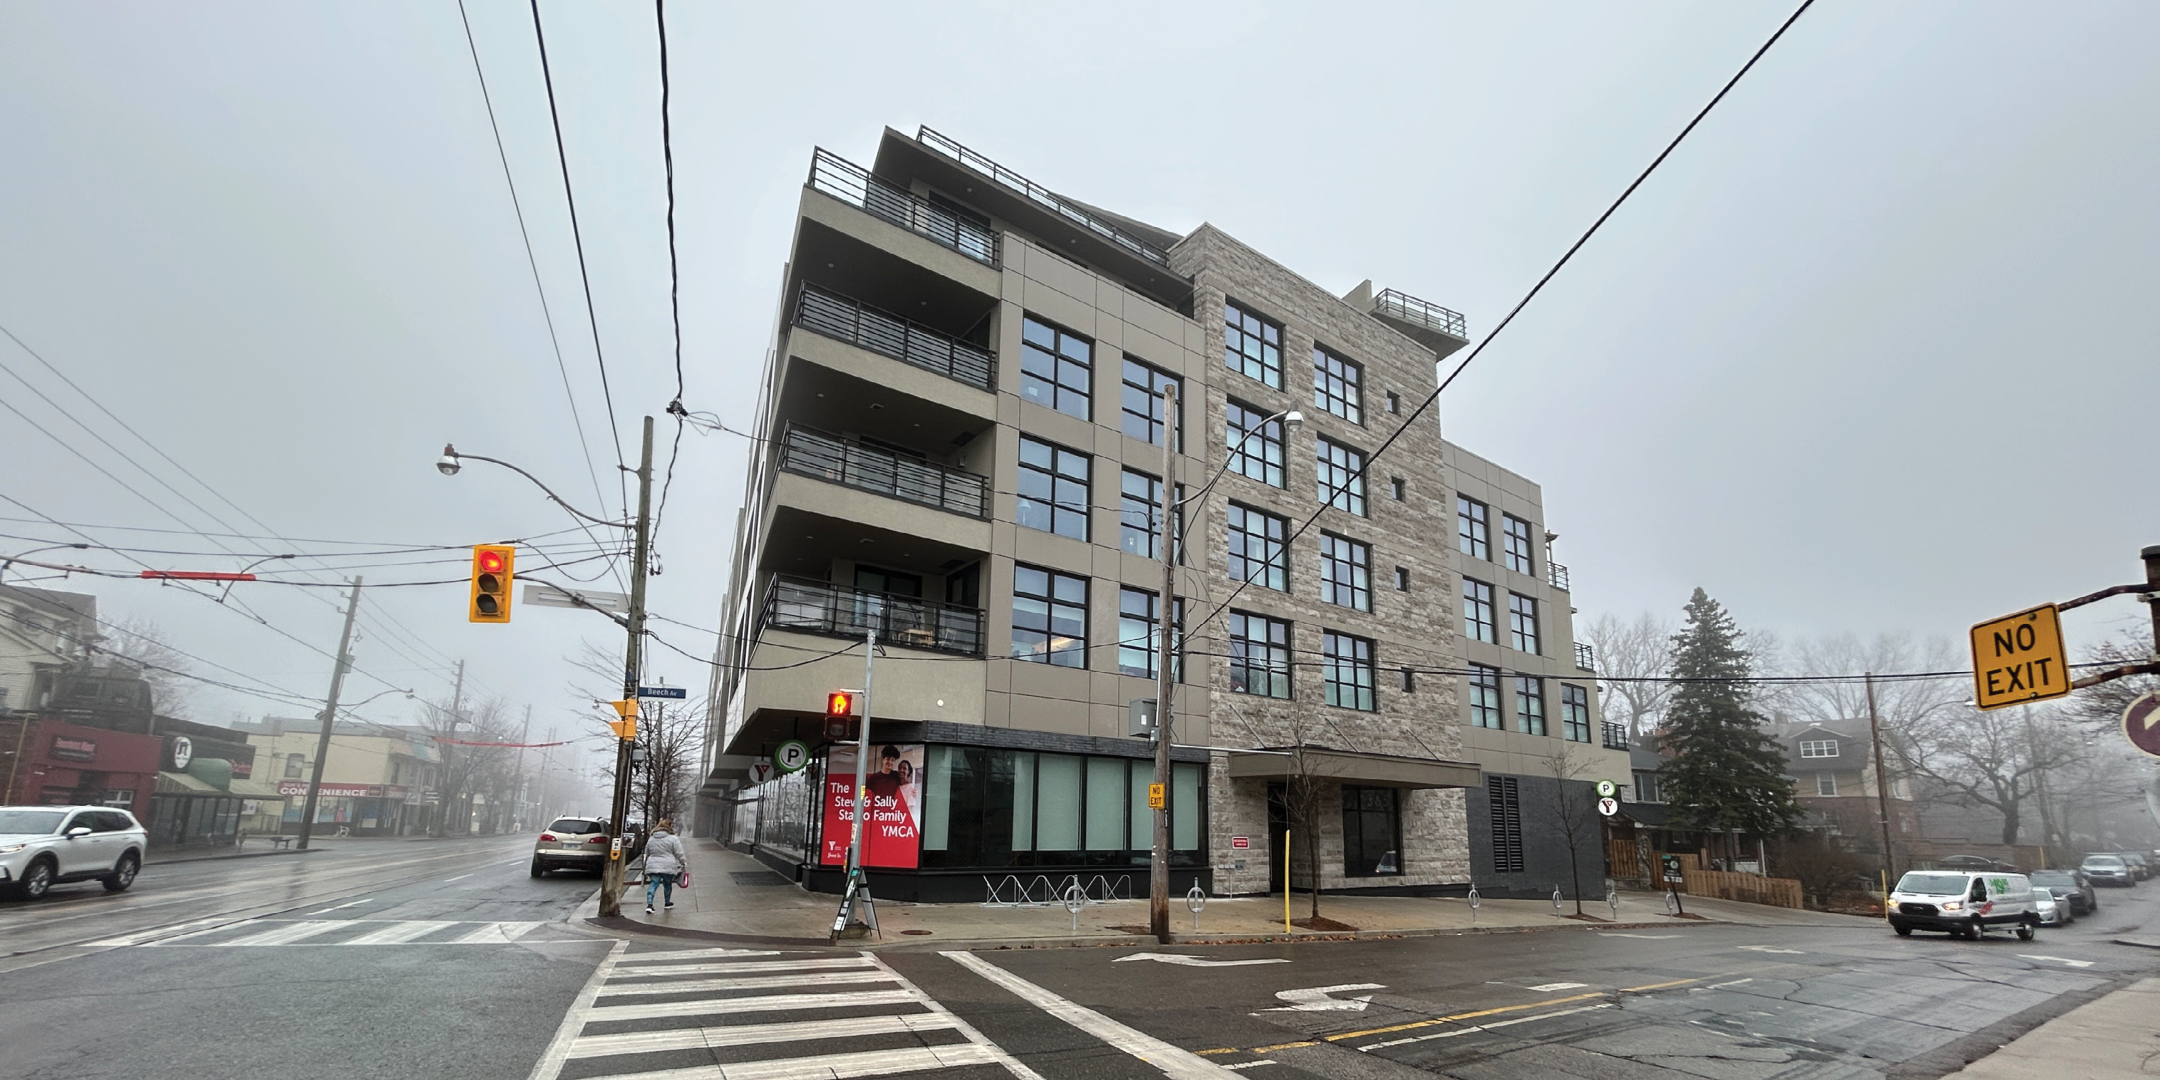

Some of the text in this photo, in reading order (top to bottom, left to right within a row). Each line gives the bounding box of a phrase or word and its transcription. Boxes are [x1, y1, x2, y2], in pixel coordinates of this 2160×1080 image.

[1993, 623, 2036, 657] NO
[1986, 657, 2052, 696] EXIT
[647, 688, 669, 696] Beech
[787, 748, 800, 763] P
[280, 787, 367, 797] CONENIENCE
[830, 782, 849, 793] The
[1152, 786, 1161, 795] NO
[1602, 784, 1610, 793] P
[834, 795, 898, 810] Stev & Sally
[1150, 796, 1162, 806] EXIT
[838, 809, 907, 824] Stao Family
[882, 825, 914, 837] YMCA
